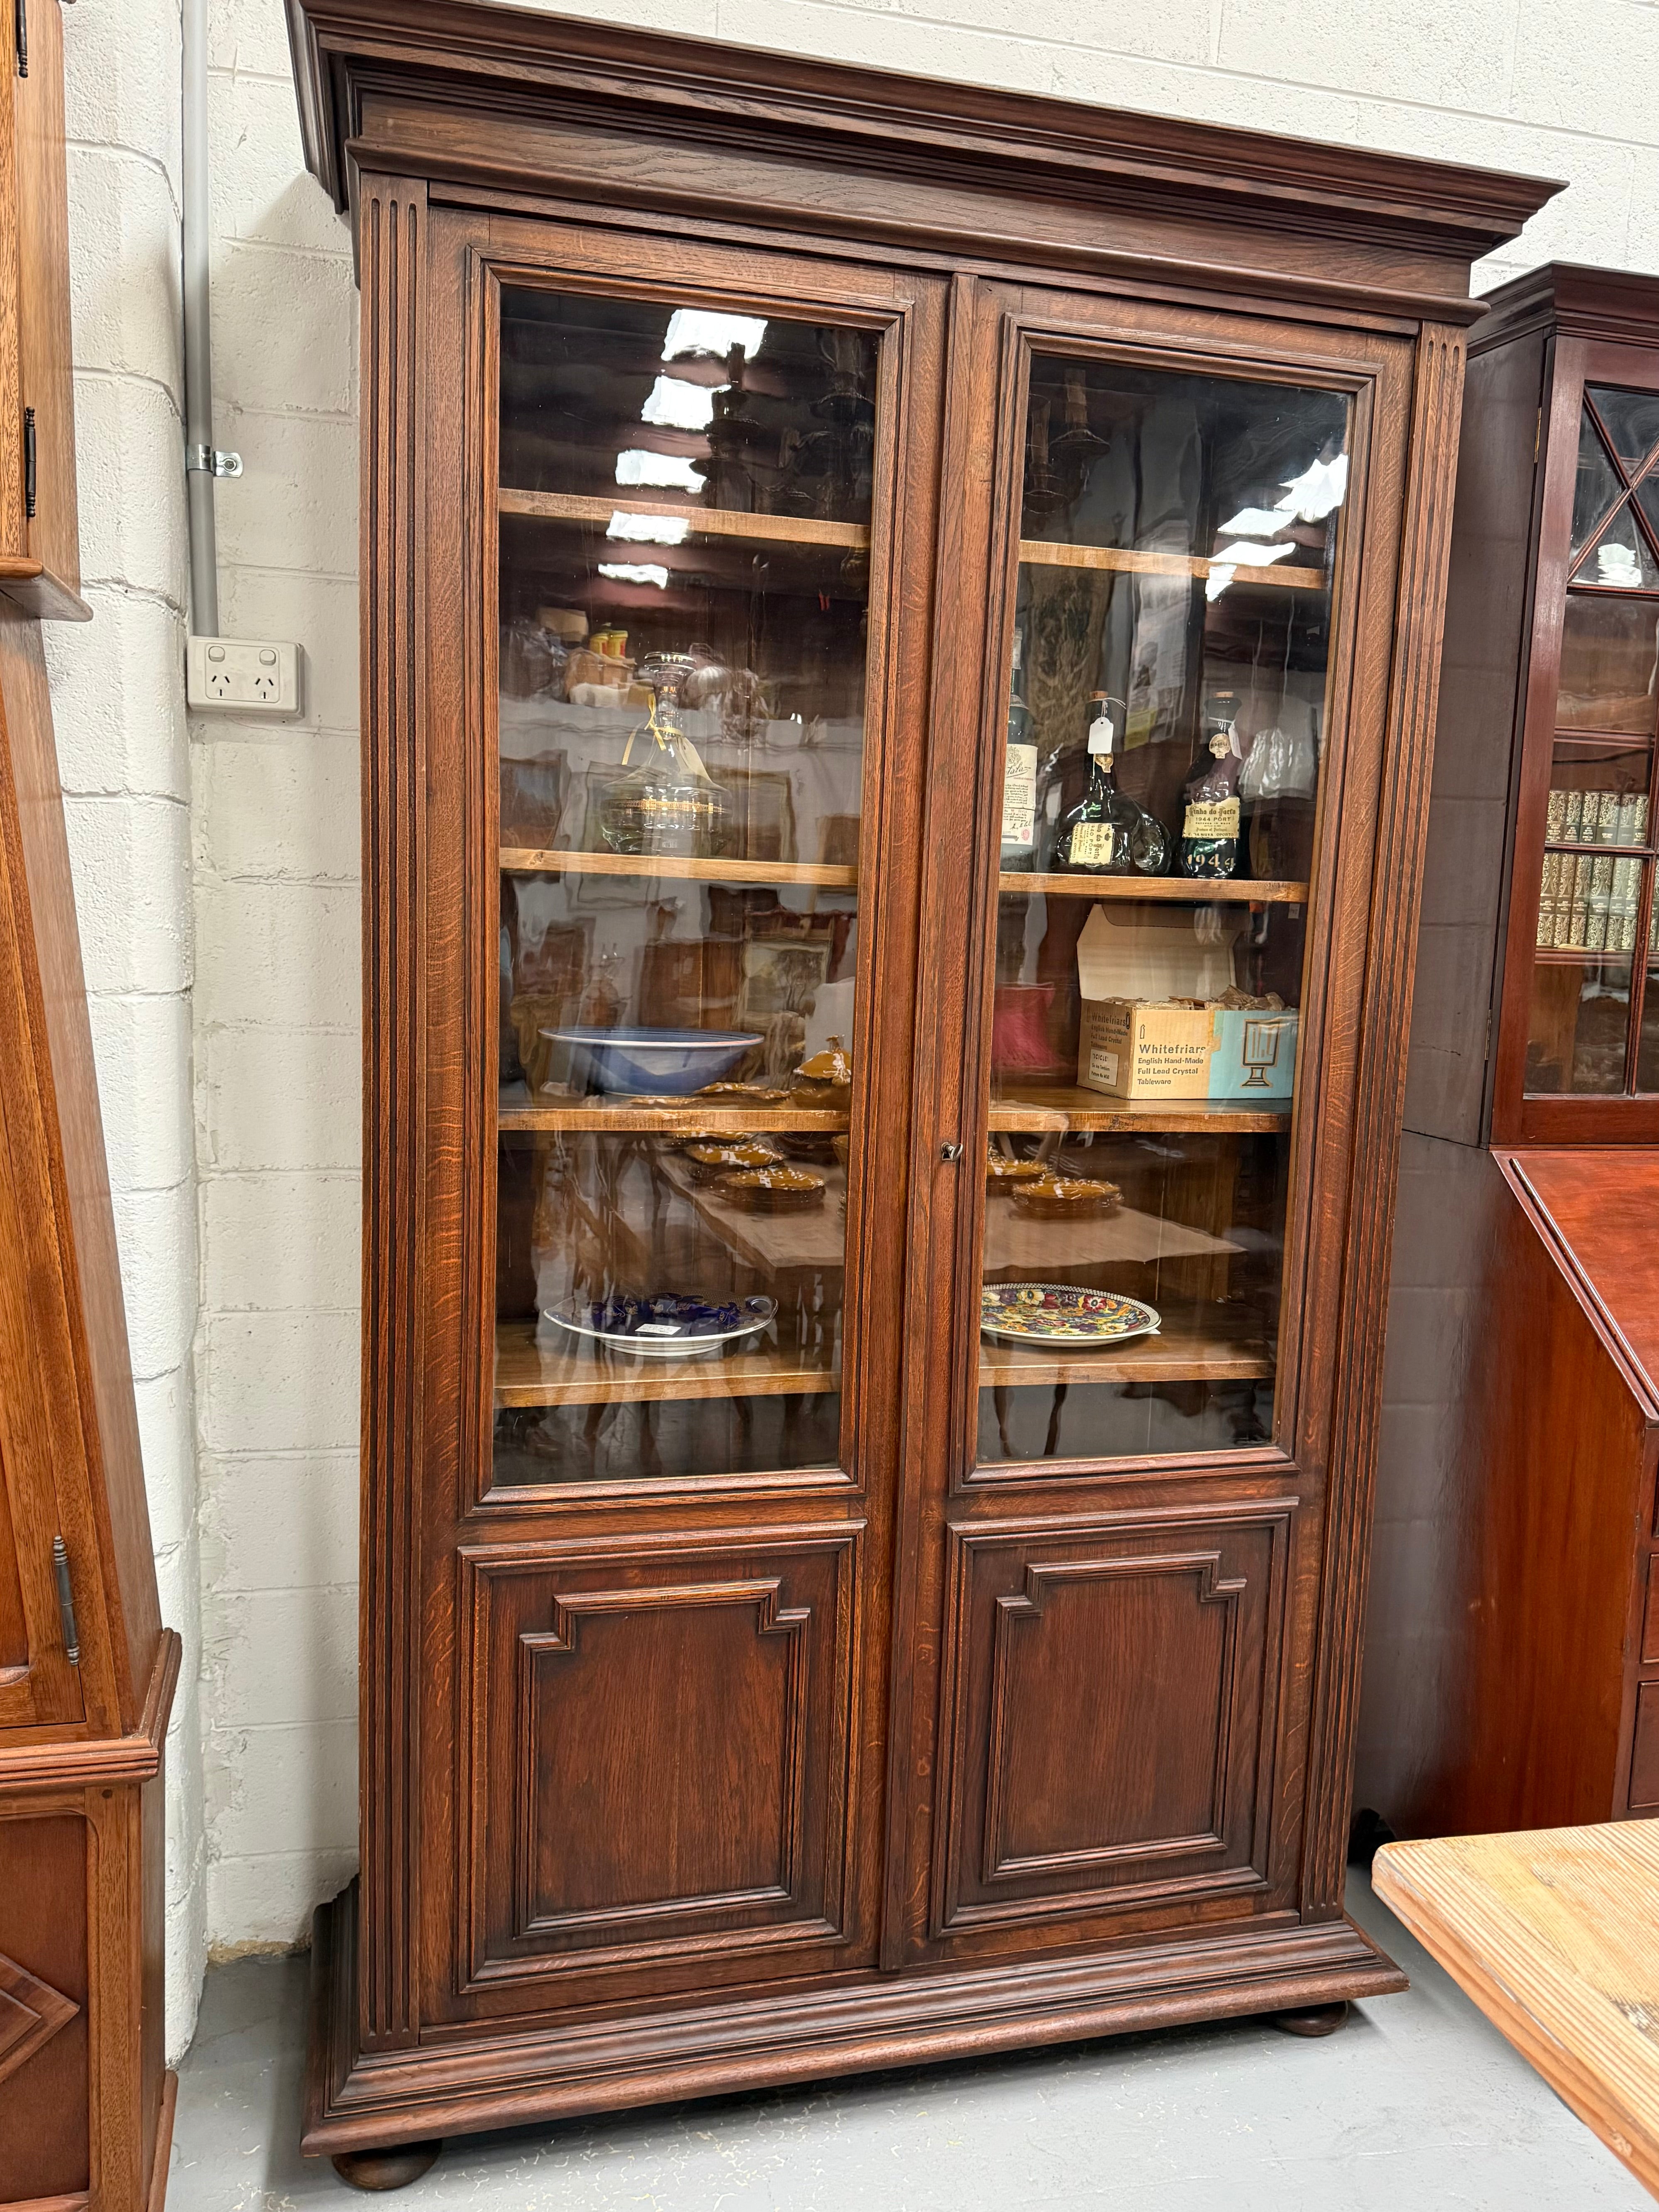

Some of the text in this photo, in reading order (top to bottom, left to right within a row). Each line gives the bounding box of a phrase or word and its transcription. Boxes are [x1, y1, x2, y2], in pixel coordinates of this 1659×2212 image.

[1187, 854, 1236, 869] 1944
[1092, 1012, 1126, 1026] Whitefriars
[1139, 1044, 1206, 1054] Whitefriars
